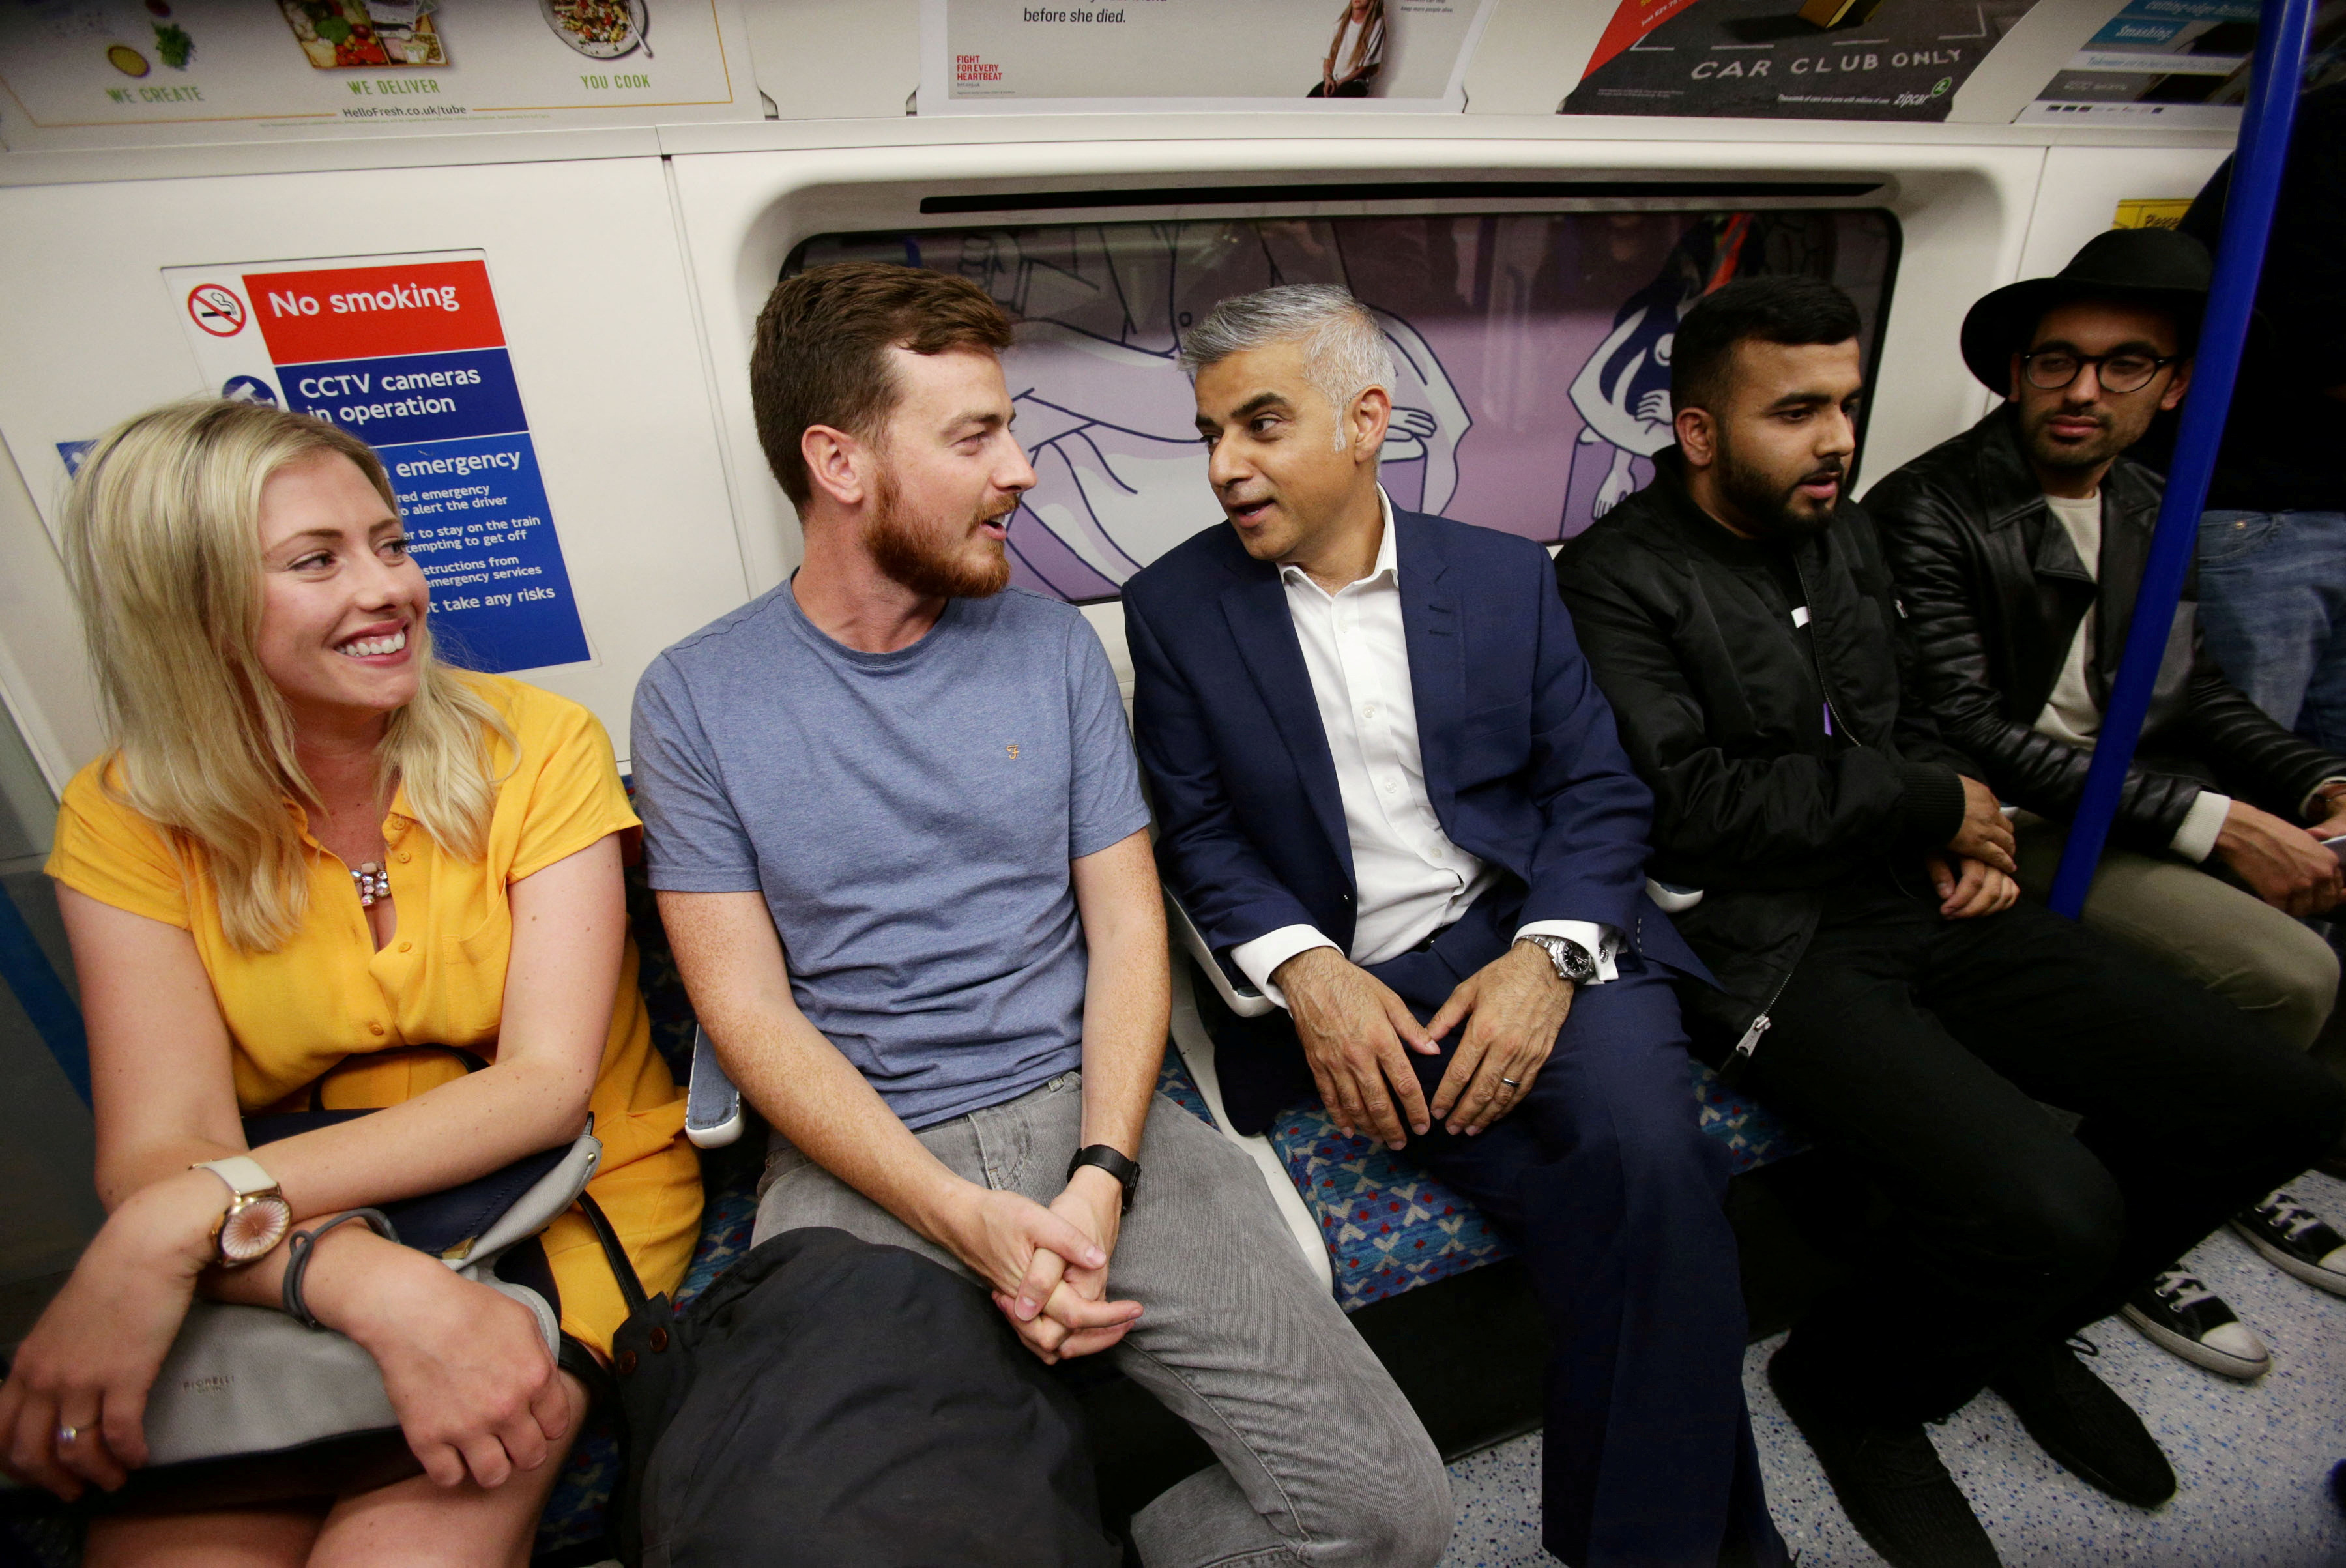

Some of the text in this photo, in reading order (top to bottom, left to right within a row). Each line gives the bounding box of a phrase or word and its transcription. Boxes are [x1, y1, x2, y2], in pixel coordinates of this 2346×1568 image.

[1024, 8, 1126, 23] before she died.
[1691, 49, 1962, 80] CAR CLUB ONLY
[347, 78, 441, 95] WE DELIVER
[580, 74, 650, 89] YOU COOK
[105, 85, 205, 104] WE CREATE
[1892, 91, 1932, 109] zipcar
[342, 104, 467, 118] HelloFresh.co.uk/tube
[268, 282, 460, 318] No smoking
[299, 369, 481, 398] CCTV cameras
[306, 395, 456, 425] in operation
[396, 451, 521, 478] emergency
[397, 485, 490, 503] red emergency
[399, 495, 508, 517] o alert the driver
[418, 529, 434, 539] to
[437, 526, 463, 537] stay
[467, 523, 484, 533] on
[485, 519, 508, 530] the
[511, 515, 541, 529] train
[405, 529, 527, 553] tempting to get off
[422, 555, 519, 575] structions from
[493, 565, 542, 580] services
[443, 596, 480, 611] take
[485, 592, 512, 607] any
[517, 587, 556, 602] risks
[1006, 744, 1021, 760] F
